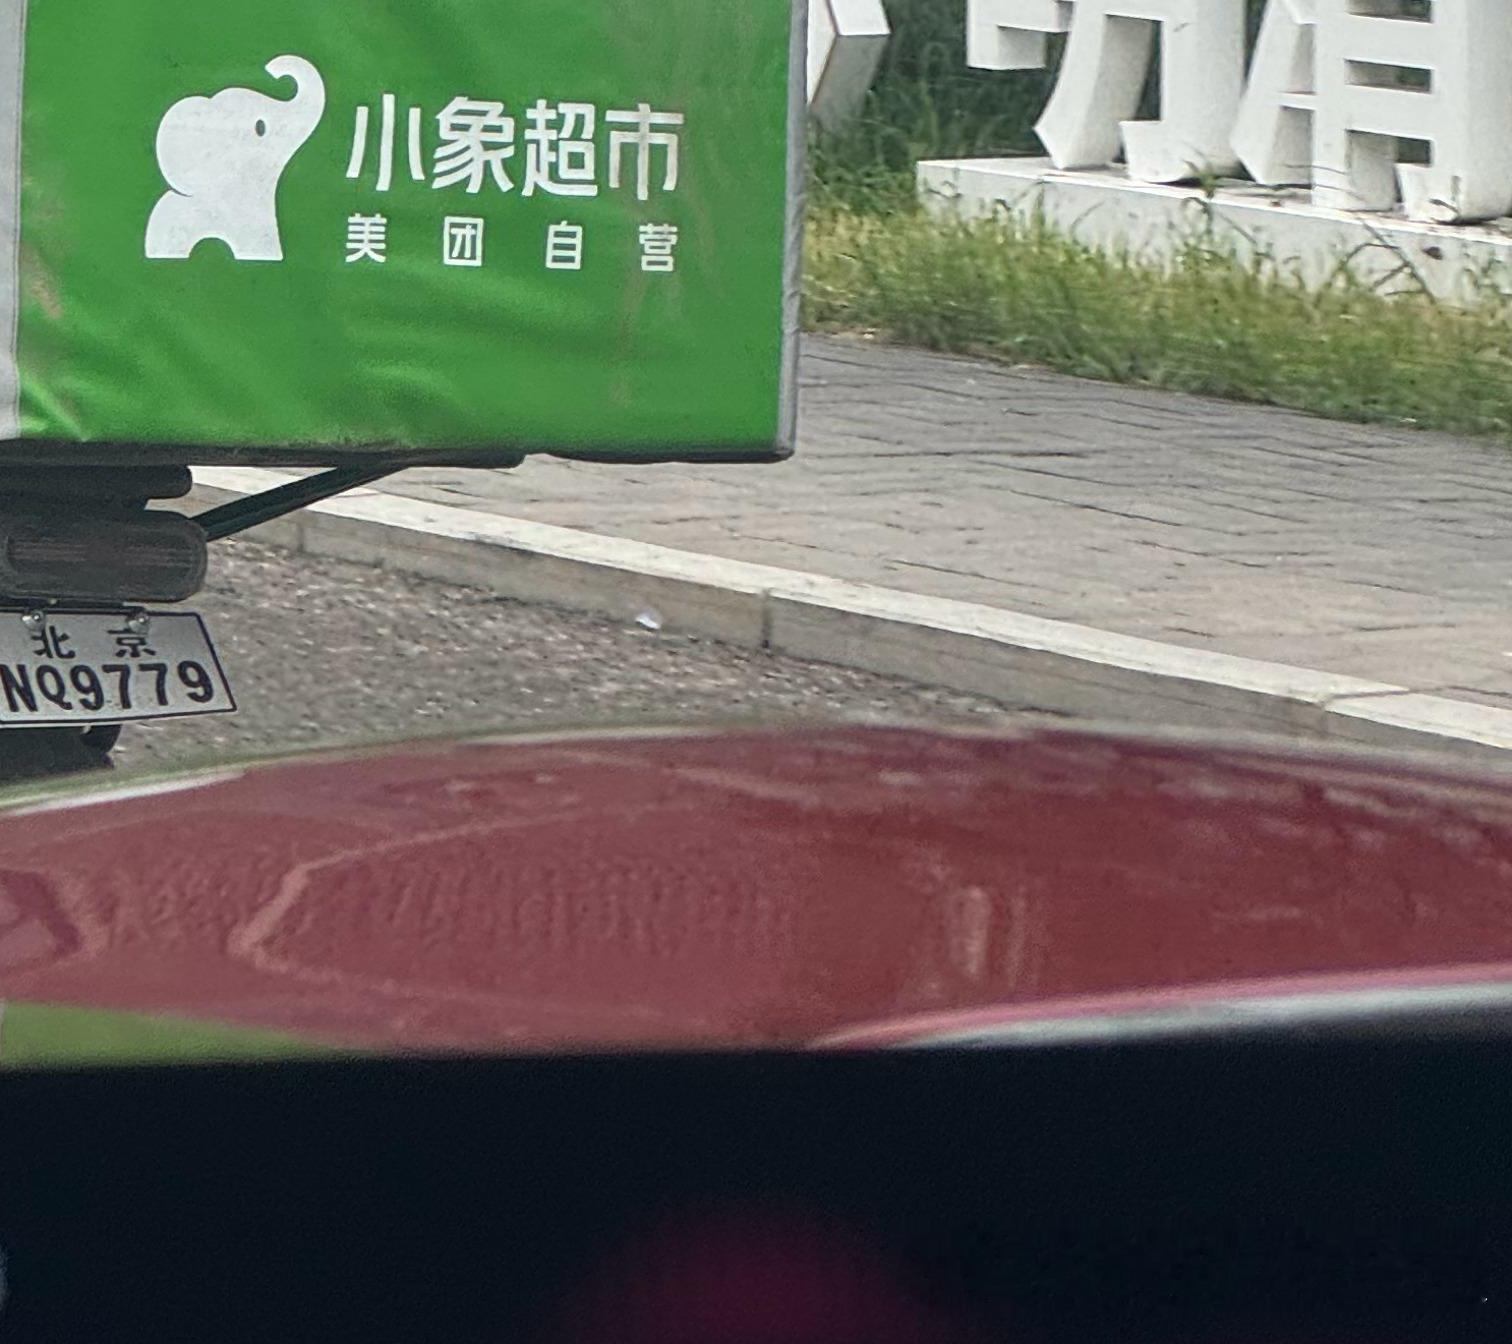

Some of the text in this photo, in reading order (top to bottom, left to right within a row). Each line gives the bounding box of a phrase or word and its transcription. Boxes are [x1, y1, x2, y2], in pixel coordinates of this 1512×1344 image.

[346, 94, 684, 200] 小象超市
[345, 213, 678, 271] 美团自营
[30, 625, 156, 659] 北京
